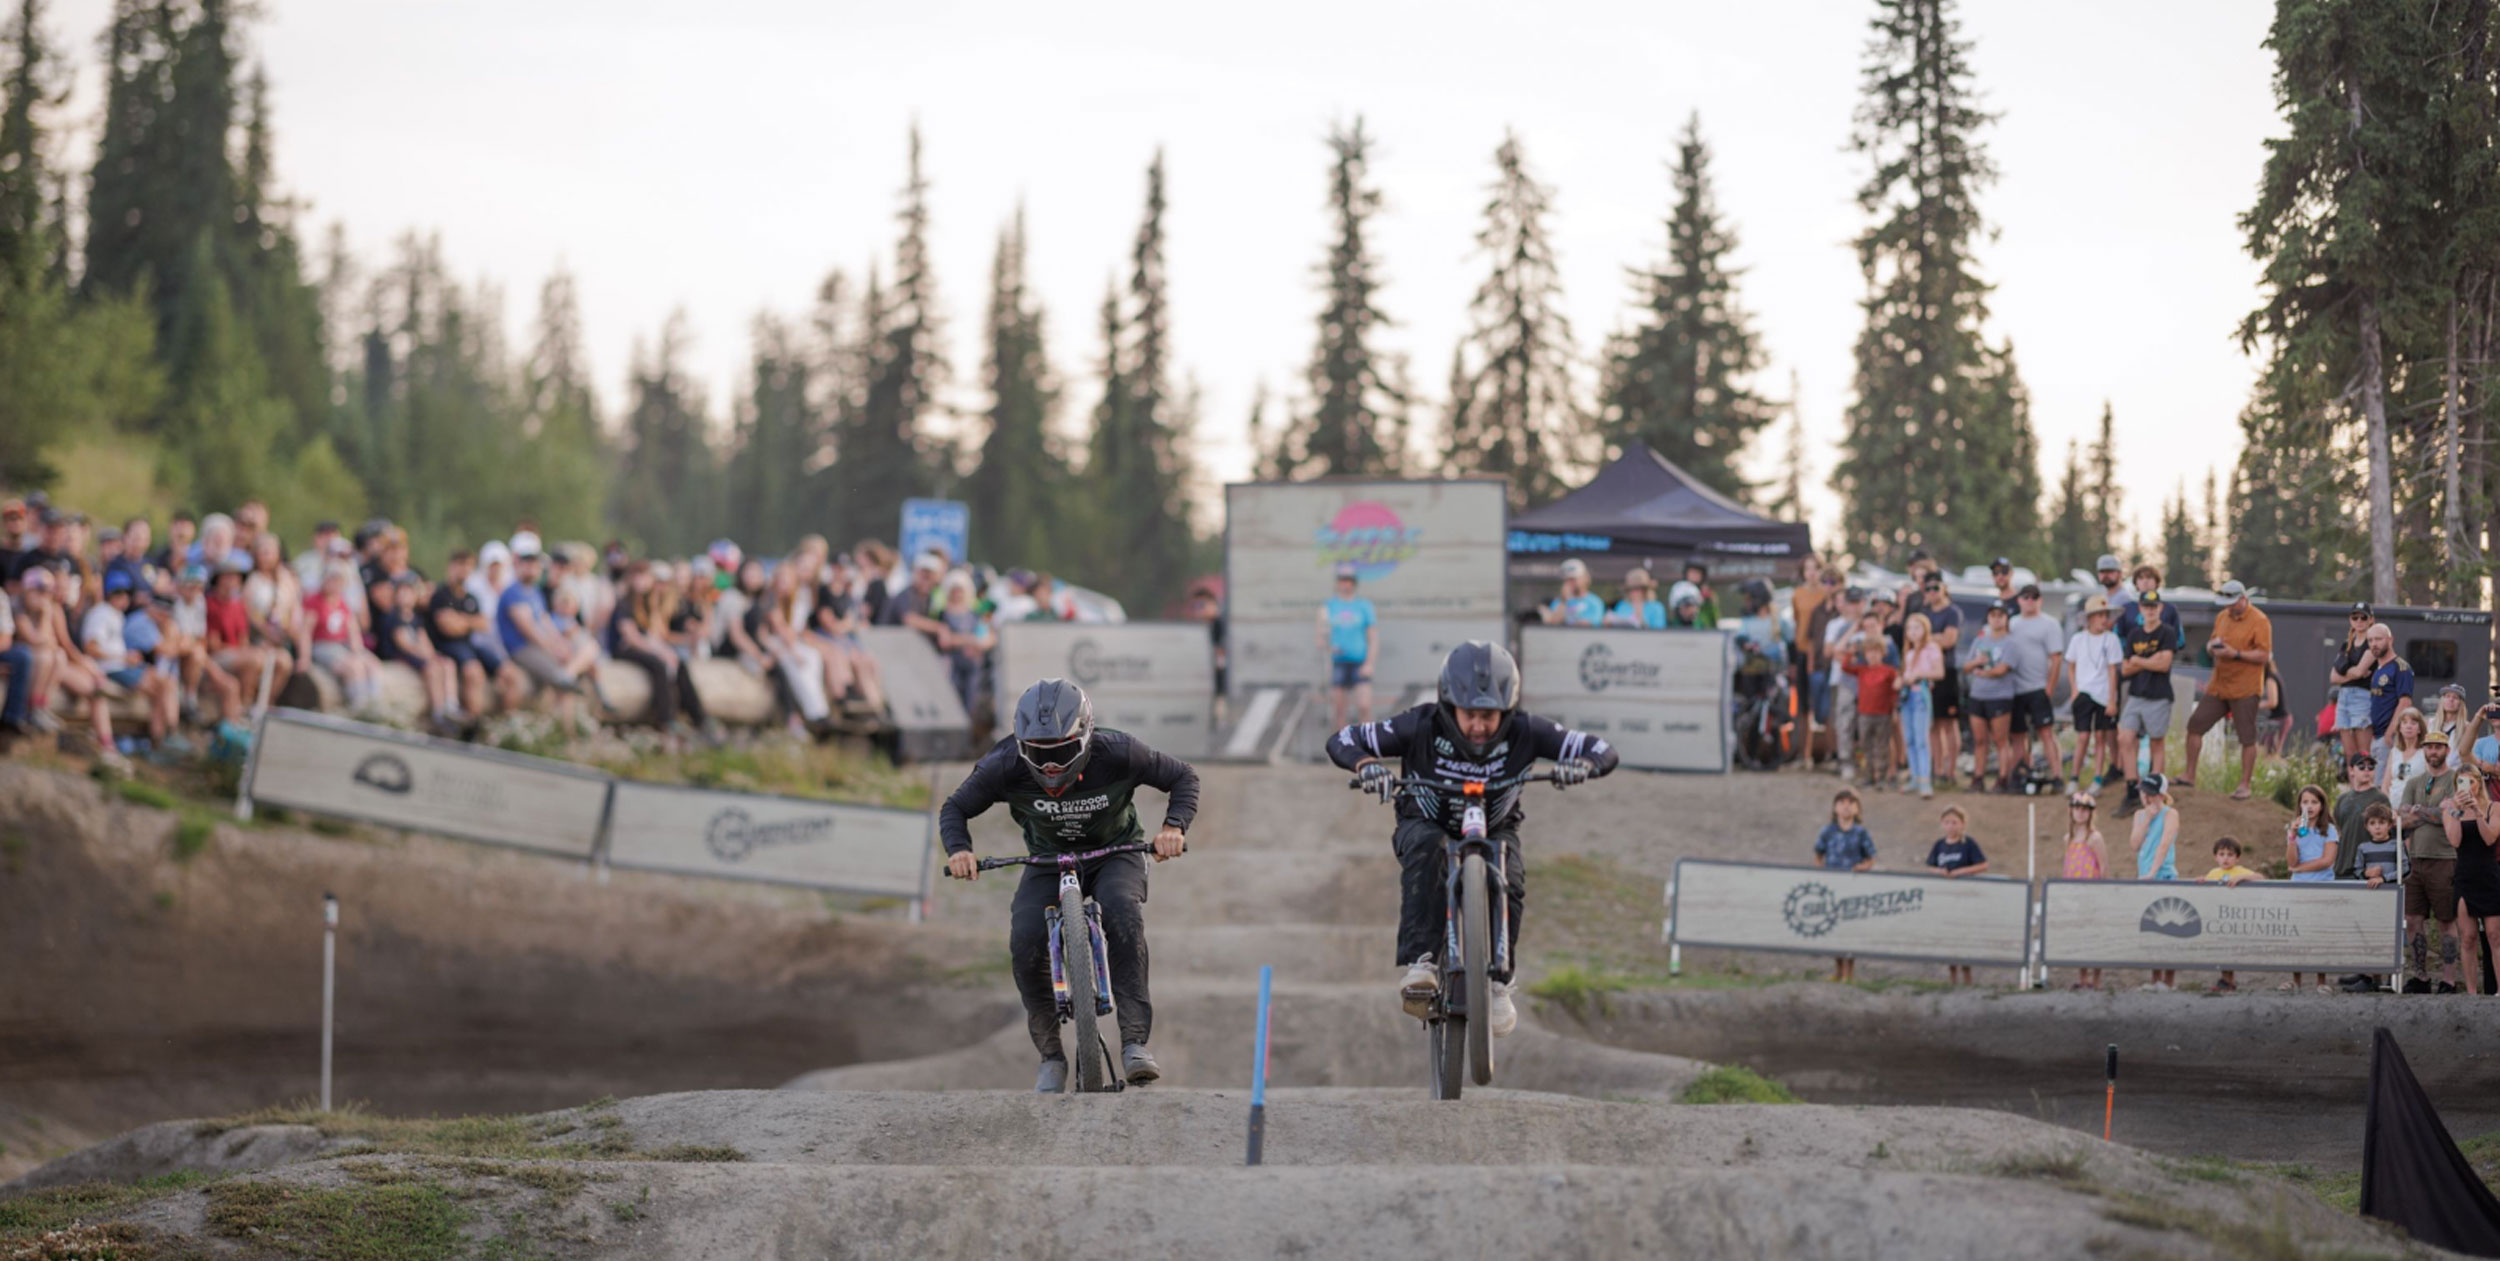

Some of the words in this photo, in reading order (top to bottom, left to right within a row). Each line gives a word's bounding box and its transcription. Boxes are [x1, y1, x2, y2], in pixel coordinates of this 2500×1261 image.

[1033, 799, 1060, 813] OR
[1061, 795, 1108, 807] OUTDOOR
[1062, 802, 1109, 813] RESEARCH
[1802, 888, 1924, 917] SILVERSTAR
[2218, 904, 2290, 921] BRITISH
[2206, 919, 2300, 937] COLUMBIA
